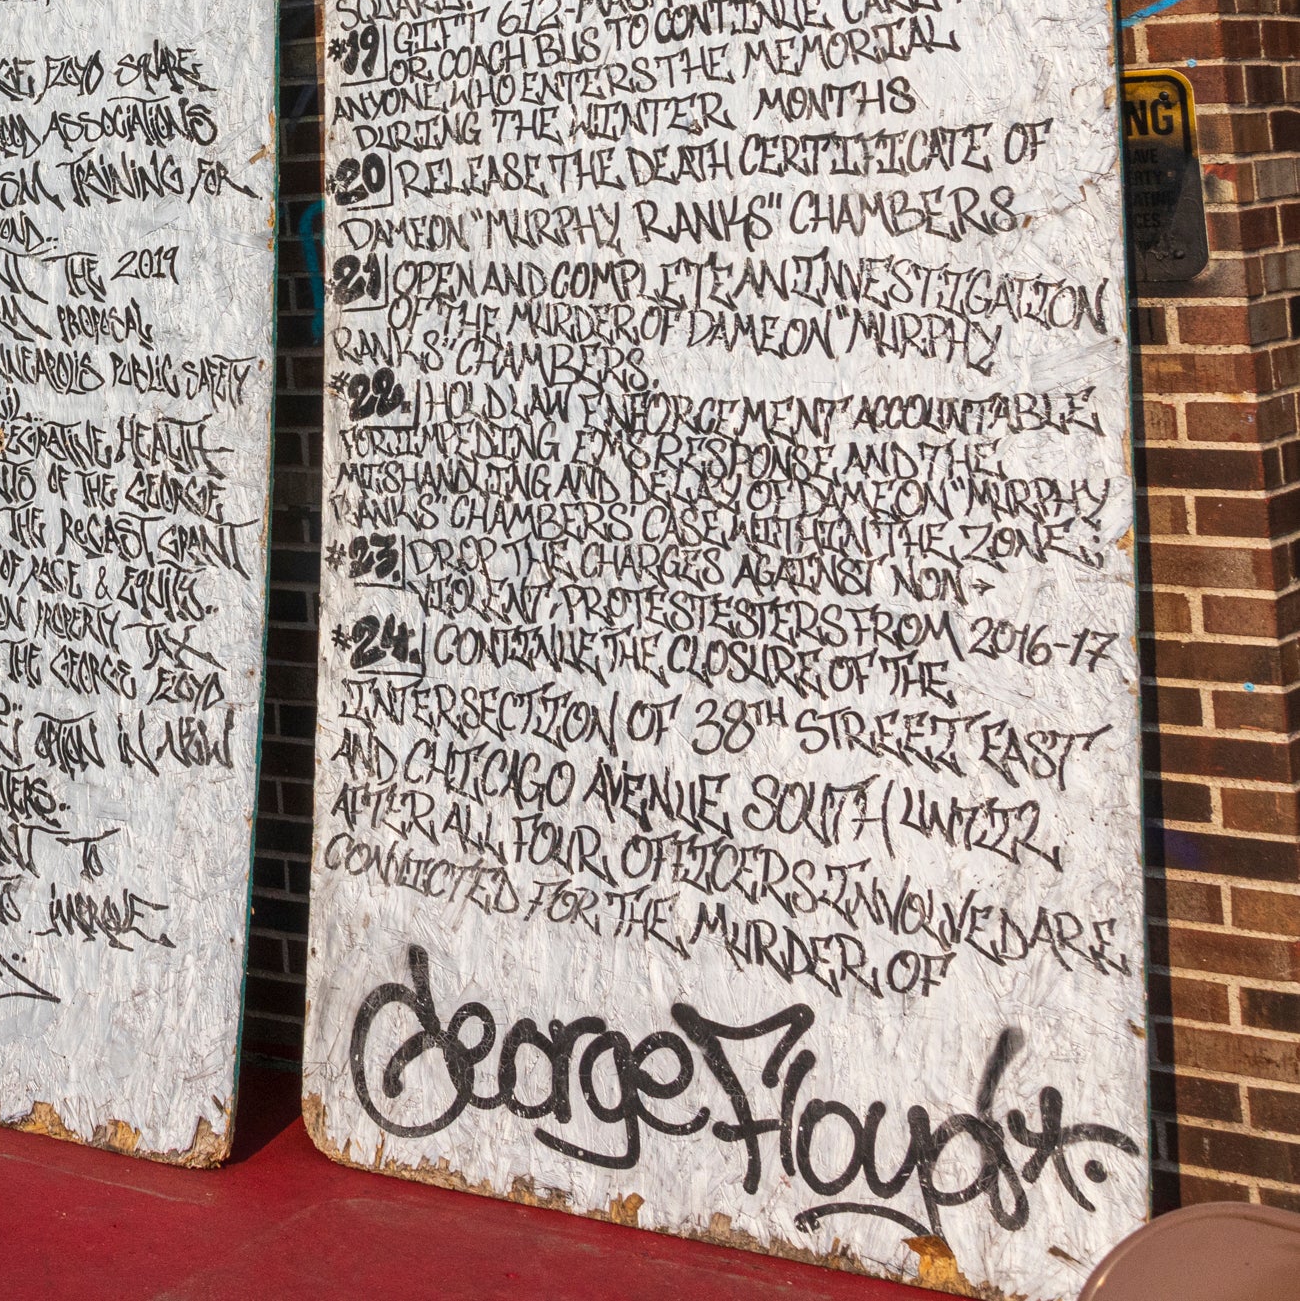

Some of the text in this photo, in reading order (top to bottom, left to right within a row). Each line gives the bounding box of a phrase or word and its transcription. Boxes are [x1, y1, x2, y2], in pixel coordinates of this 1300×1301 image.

[389, 56, 434, 87] OR
[439, 39, 528, 80] COACH
[533, 27, 603, 67] BUS
[606, 15, 649, 50] TO
[394, 6, 489, 56] GIFT
[353, 76, 917, 152] DURING THE WINTER MONTHS
[394, 146, 549, 199] RELEASE
[550, 144, 626, 194] THE
[625, 139, 735, 187] DEATH
[738, 122, 993, 177] CERTIFICATE
[1004, 118, 1053, 165] OF
[338, 209, 470, 252] DAMEON
[789, 185, 1017, 243] CHAMBERS
[43, 250, 106, 303] THE
[110, 246, 182, 284] 2019
[433, 624, 604, 678] CONTINUE
[602, 622, 670, 687] THE
[667, 634, 828, 700] CLOSURE
[829, 649, 877, 695] OF
[879, 650, 957, 708] THE
[338, 677, 1113, 791] INTERSECTION OF 38TH STREET EAST
[331, 727, 398, 786] AND
[404, 738, 576, 812] CHICAGO
[585, 757, 734, 839] AVENUE
[325, 832, 956, 999] CONVICTED FOR THE MURDER OF
[331, 782, 1130, 977] AFTER ALL FOUR OFFICERS INVOLVED ARE
[350, 944, 711, 1171] George
